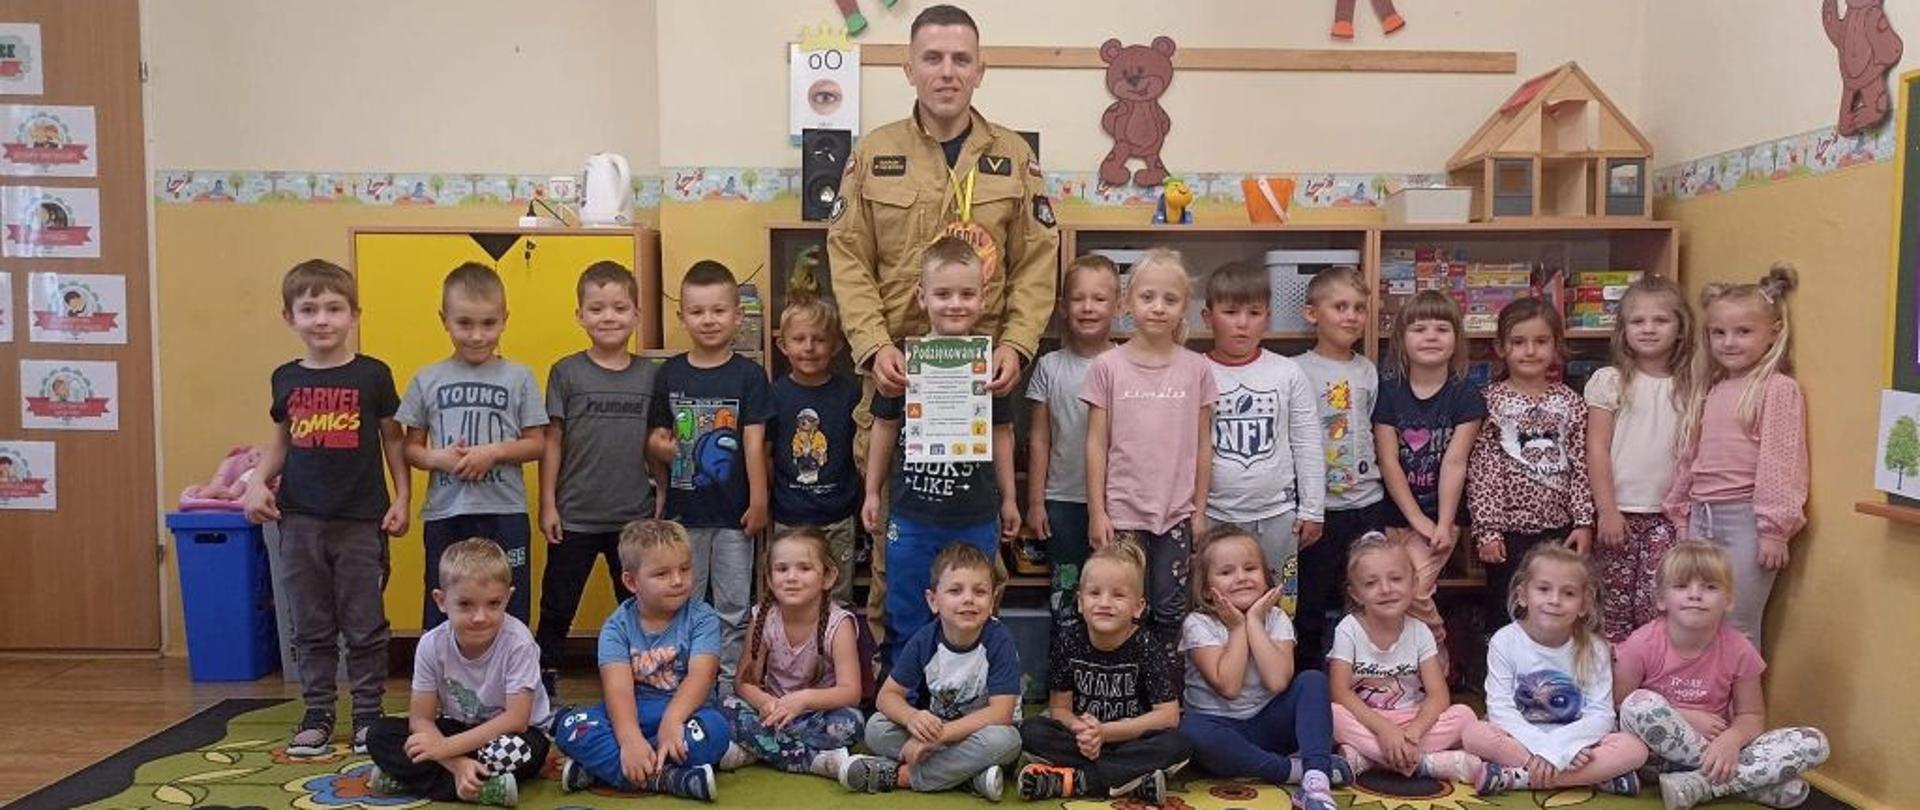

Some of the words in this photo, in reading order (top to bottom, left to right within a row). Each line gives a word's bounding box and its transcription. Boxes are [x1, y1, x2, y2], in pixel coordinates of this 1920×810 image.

[288, 387, 360, 413] MARVEL
[440, 386, 507, 407] YOUNG
[290, 412, 360, 438] COMICS
[1217, 417, 1274, 456] NFL
[912, 475, 955, 496] LIKE
[1074, 669, 1136, 697] MAKE
